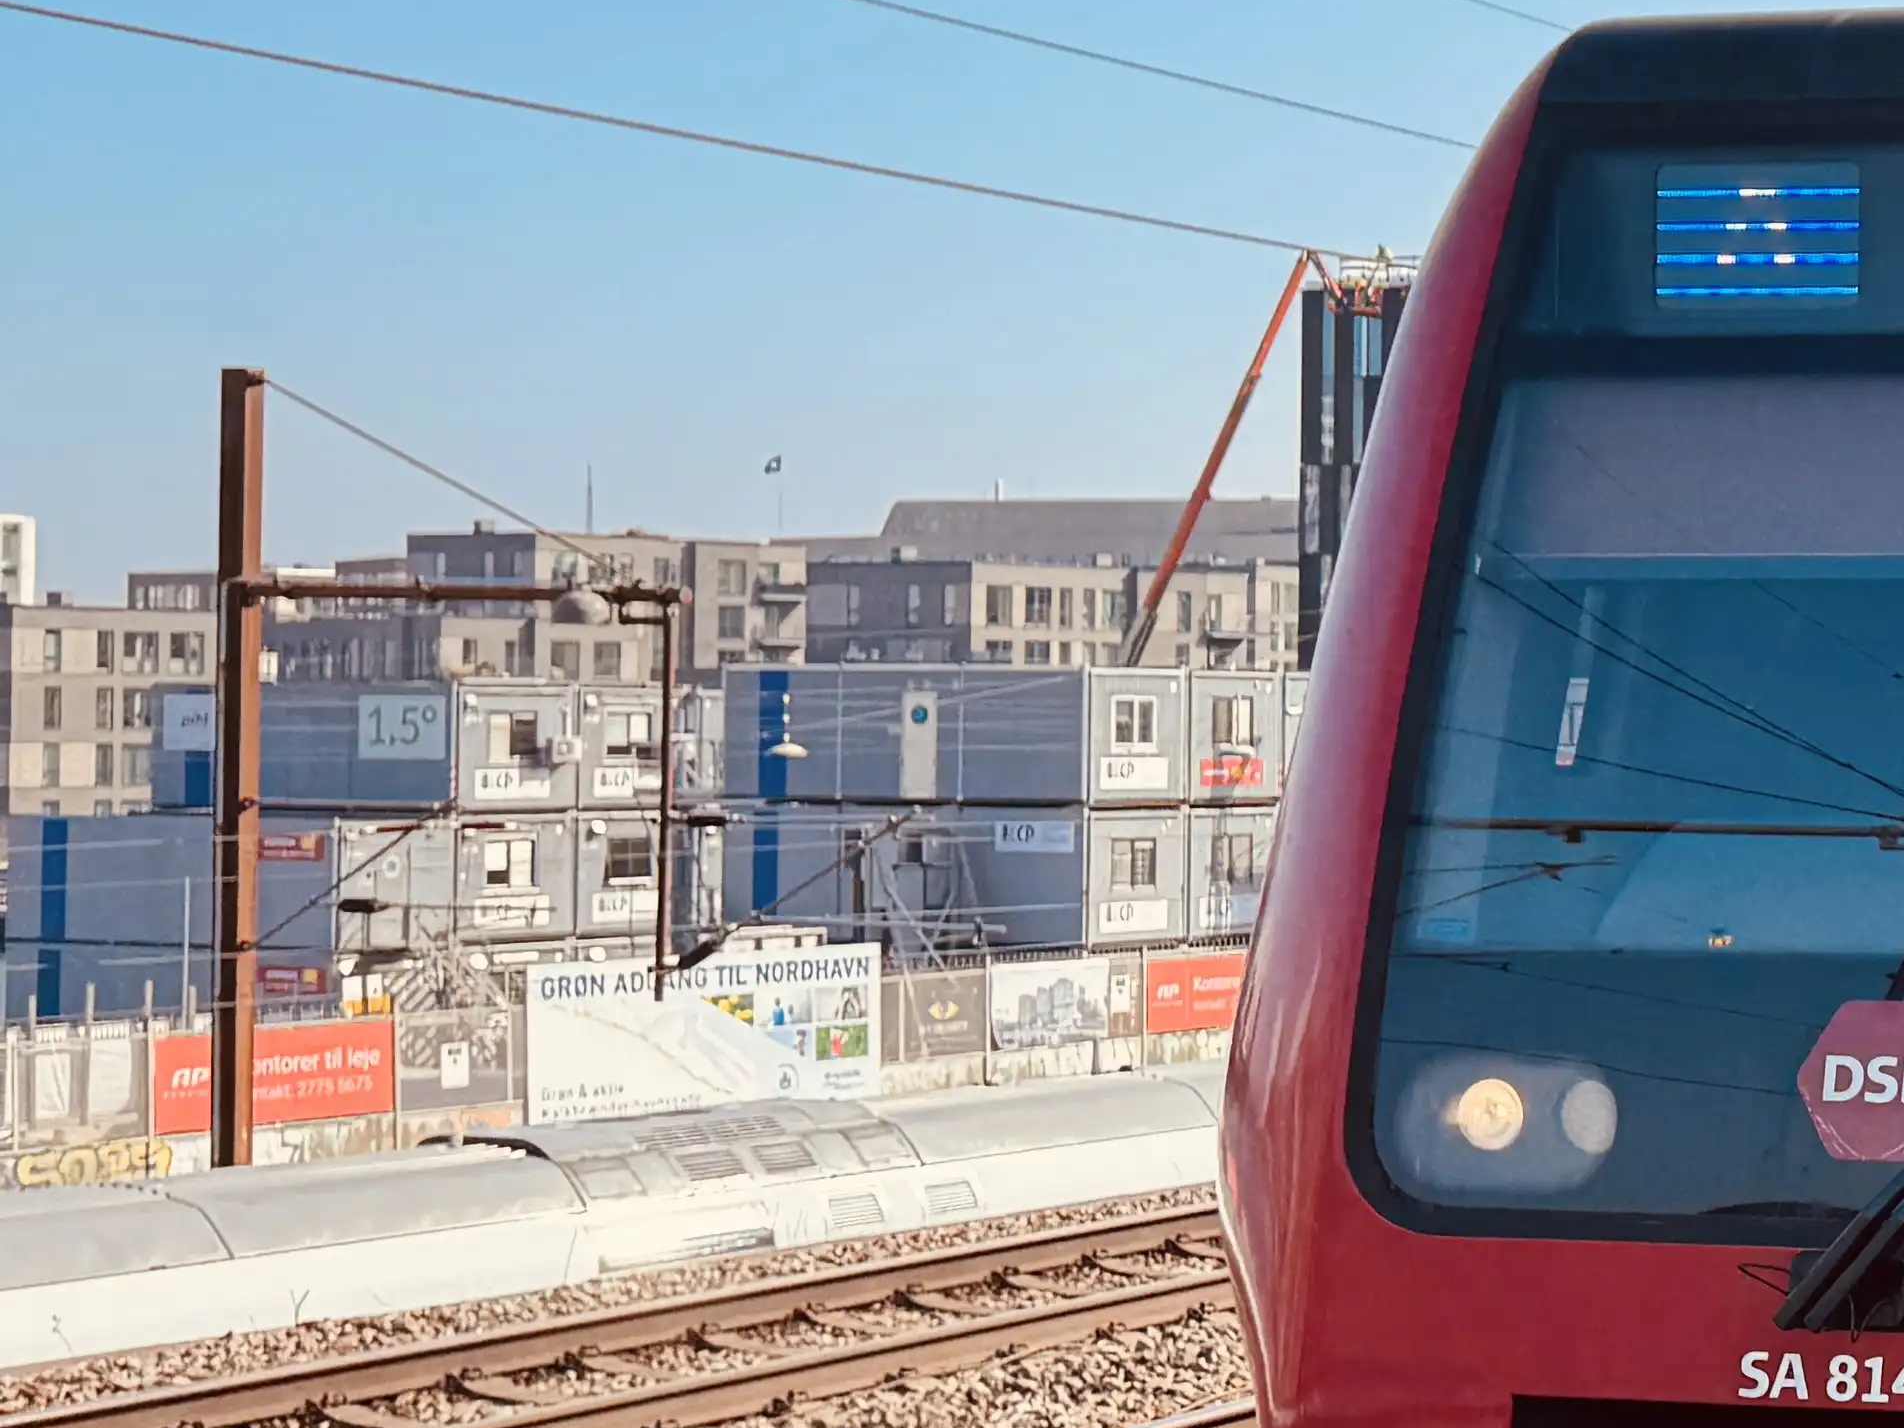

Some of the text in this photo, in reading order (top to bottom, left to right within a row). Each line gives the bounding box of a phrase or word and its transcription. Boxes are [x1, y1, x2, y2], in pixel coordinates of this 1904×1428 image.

[367, 706, 438, 747] 1,5°
[541, 973, 605, 1001] GRØN
[715, 963, 748, 988] TIL
[755, 956, 871, 985] NORDHAVN
[253, 1045, 381, 1077] ontorer til leje
[1738, 1350, 1809, 1401] SA
